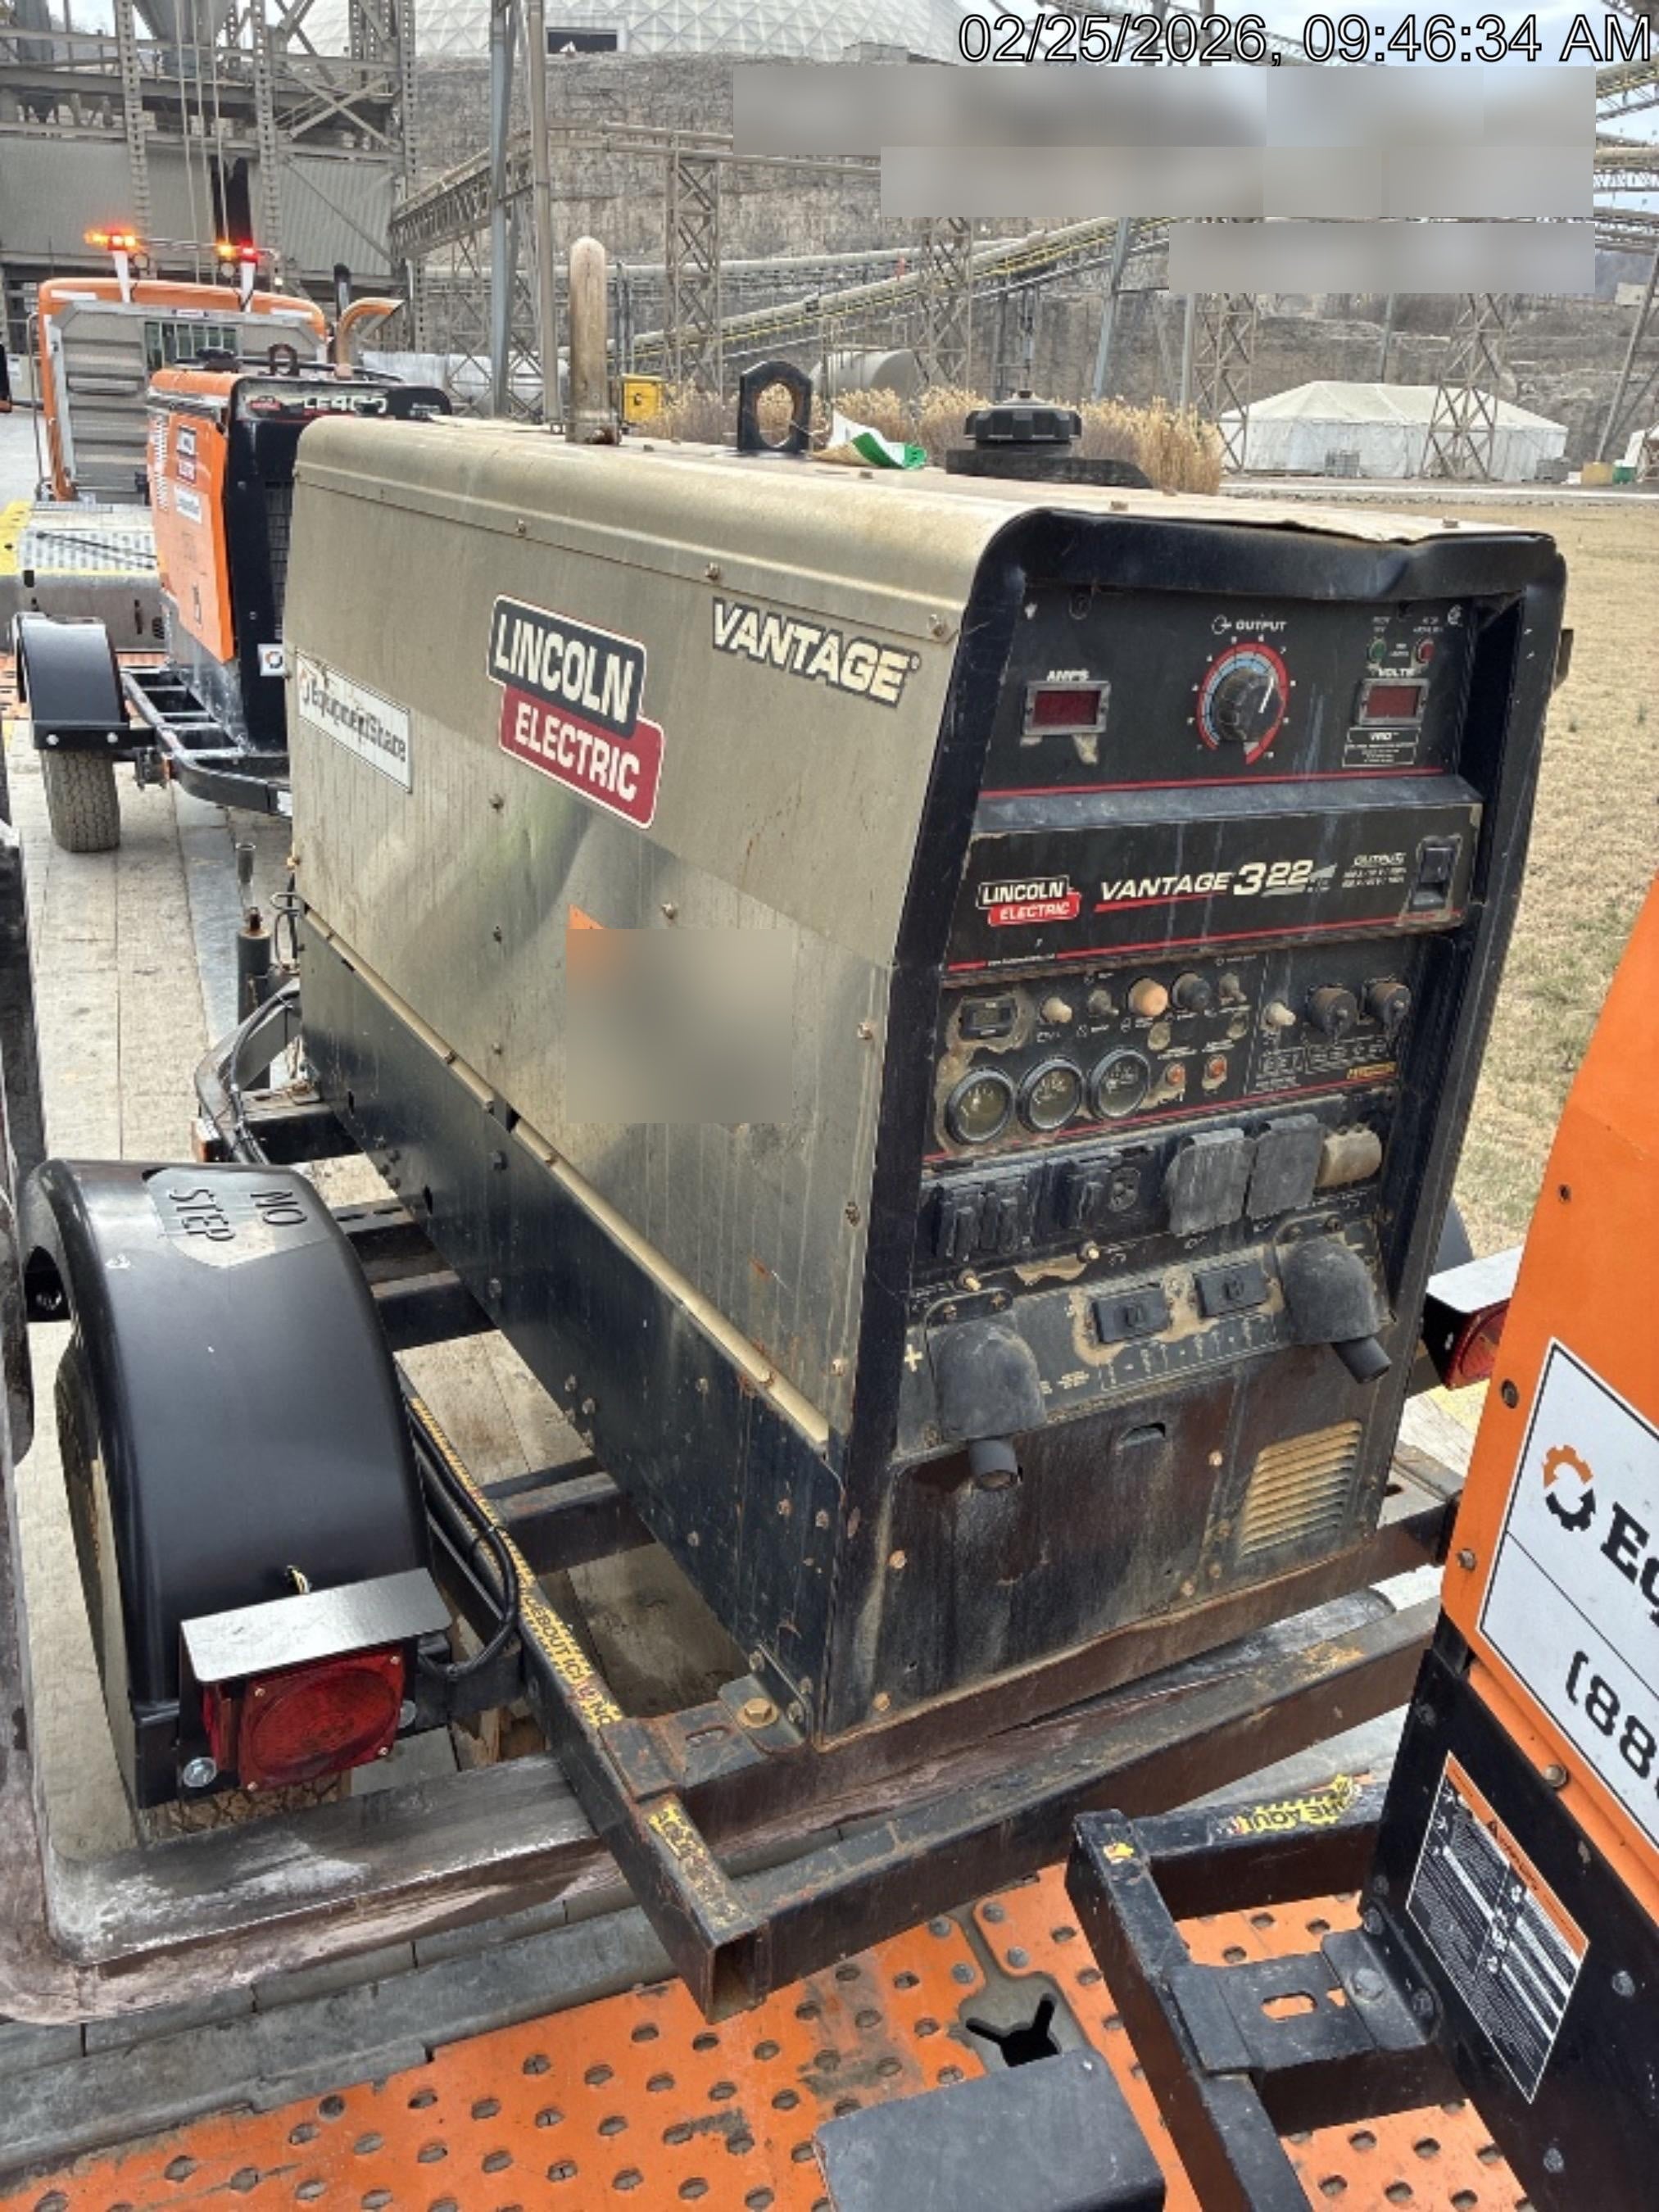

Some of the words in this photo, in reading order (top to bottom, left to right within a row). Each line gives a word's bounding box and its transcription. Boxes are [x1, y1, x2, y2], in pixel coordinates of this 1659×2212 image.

[1235, 619, 1286, 632] OUTPUT
[493, 614, 635, 724] LINCOLN
[713, 596, 911, 709] VANTAGE
[1046, 669, 1090, 682] AMPS
[514, 701, 641, 802] ELECTRIC
[982, 882, 1065, 905] LINCOLN
[1100, 873, 1233, 900] VANTAGE
[1233, 859, 1314, 896] 322
[1000, 901, 1071, 921] ELECTRIC
[169, 1189, 236, 1242] STEP
